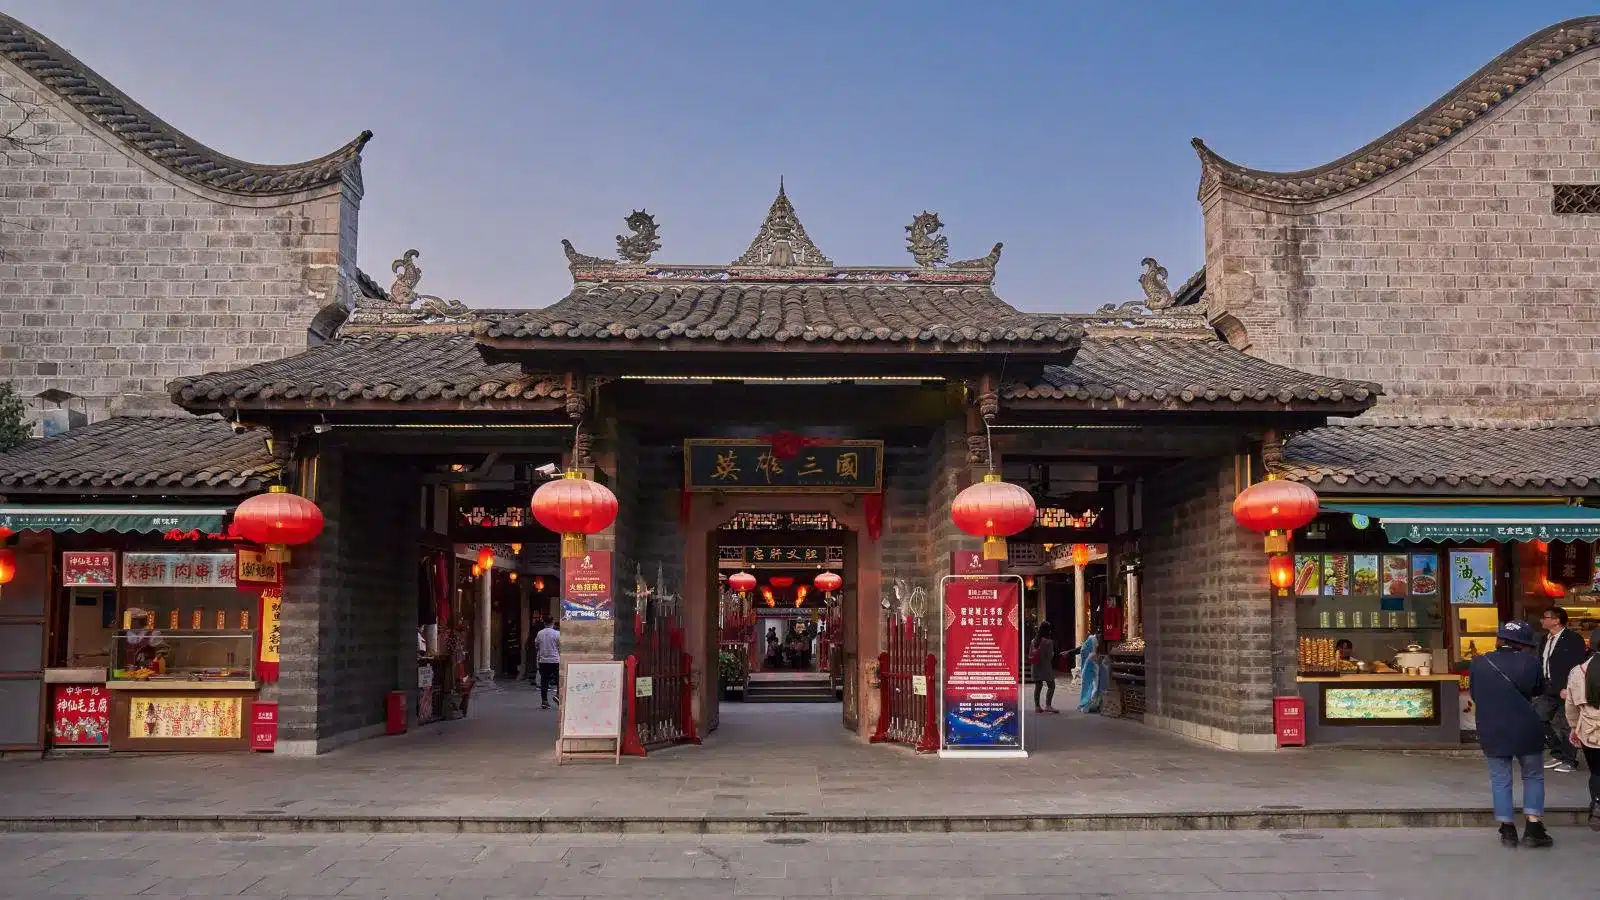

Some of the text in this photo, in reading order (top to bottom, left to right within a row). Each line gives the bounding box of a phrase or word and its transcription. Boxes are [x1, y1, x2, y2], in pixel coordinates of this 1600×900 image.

[710, 450, 858, 484] 英雄三國
[1459, 564, 1487, 599] 油茶
[57, 698, 107, 713] 神仙毛豆腐
